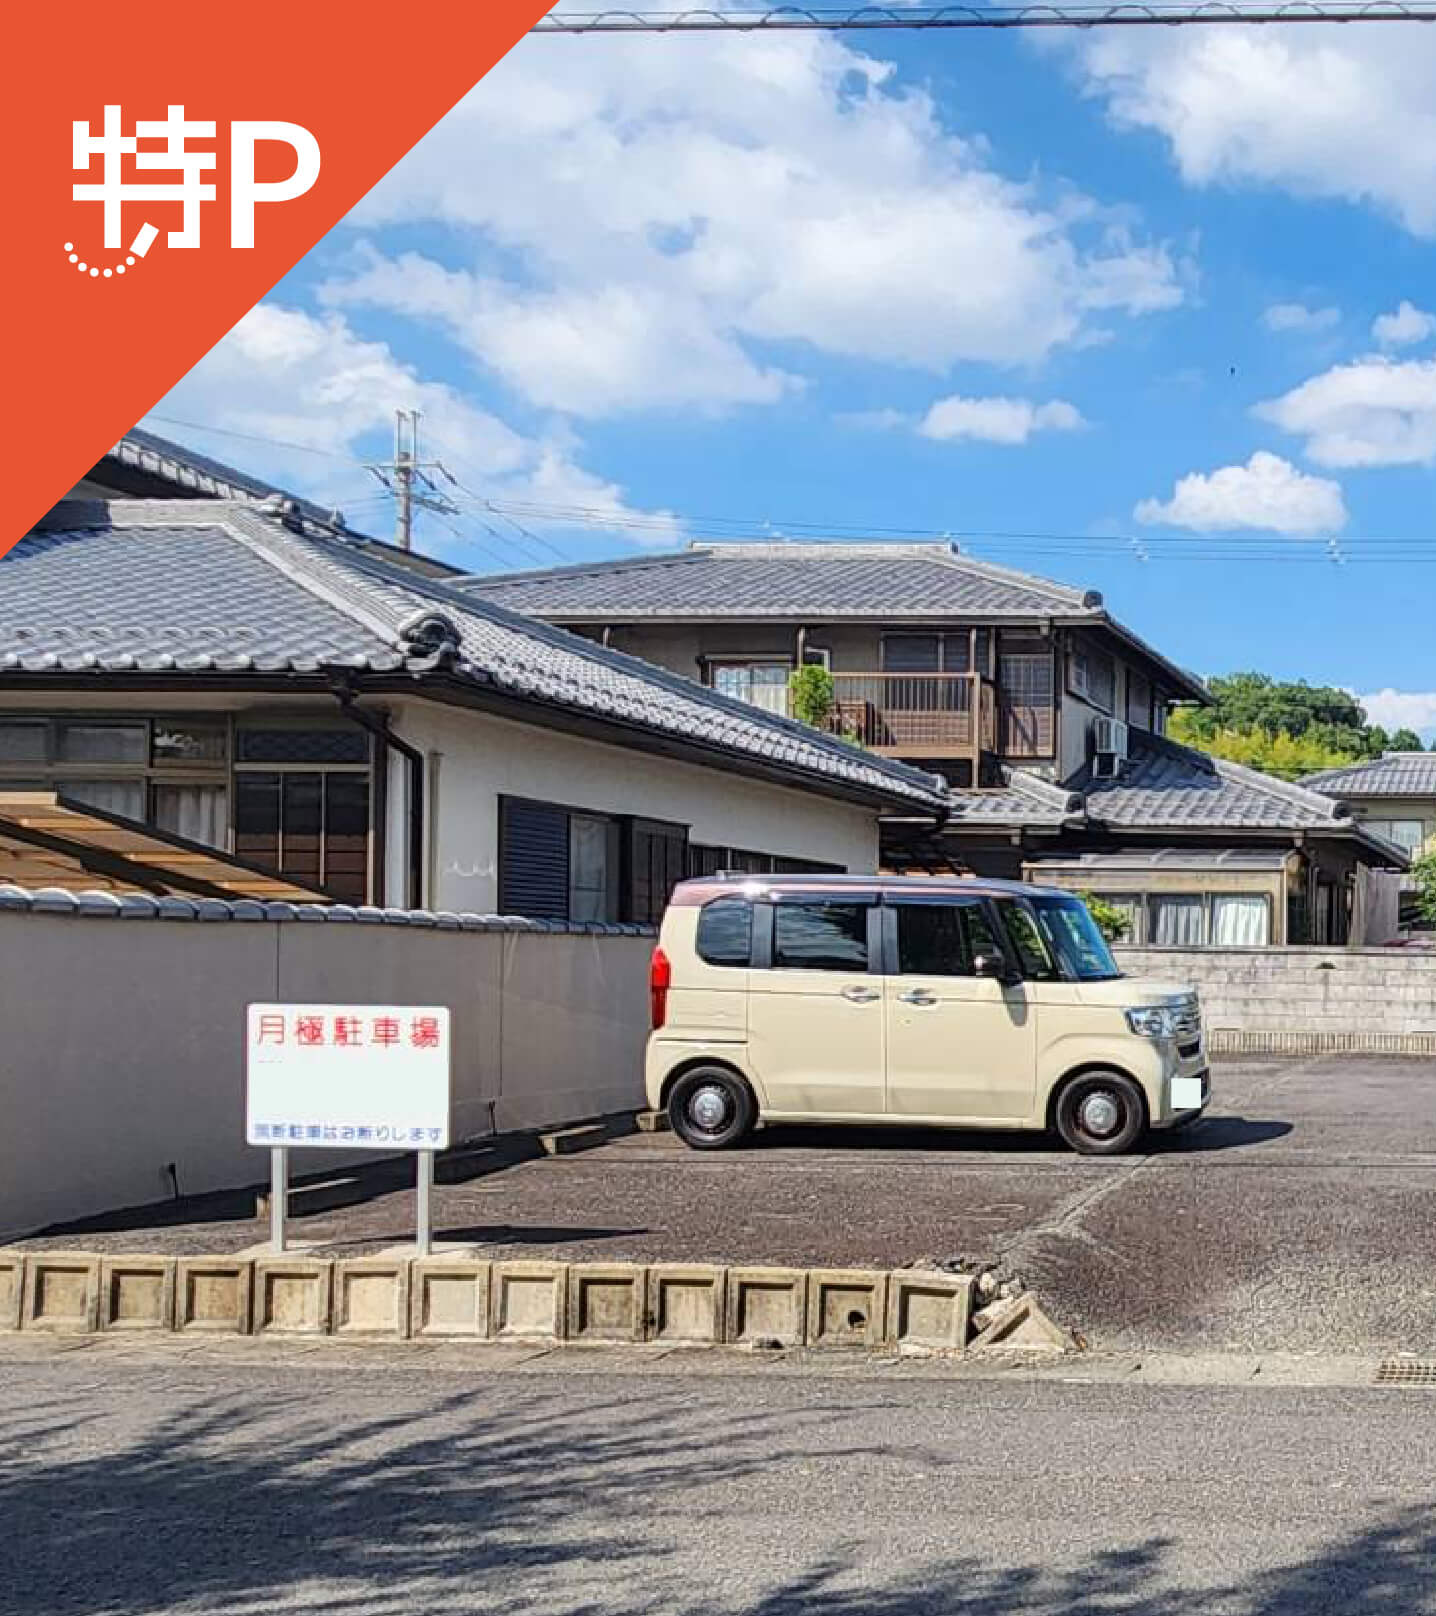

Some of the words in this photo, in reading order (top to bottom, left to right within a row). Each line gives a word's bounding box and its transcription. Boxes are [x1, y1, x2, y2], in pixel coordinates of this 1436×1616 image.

[258, 1014, 440, 1048] 月極駐車場
